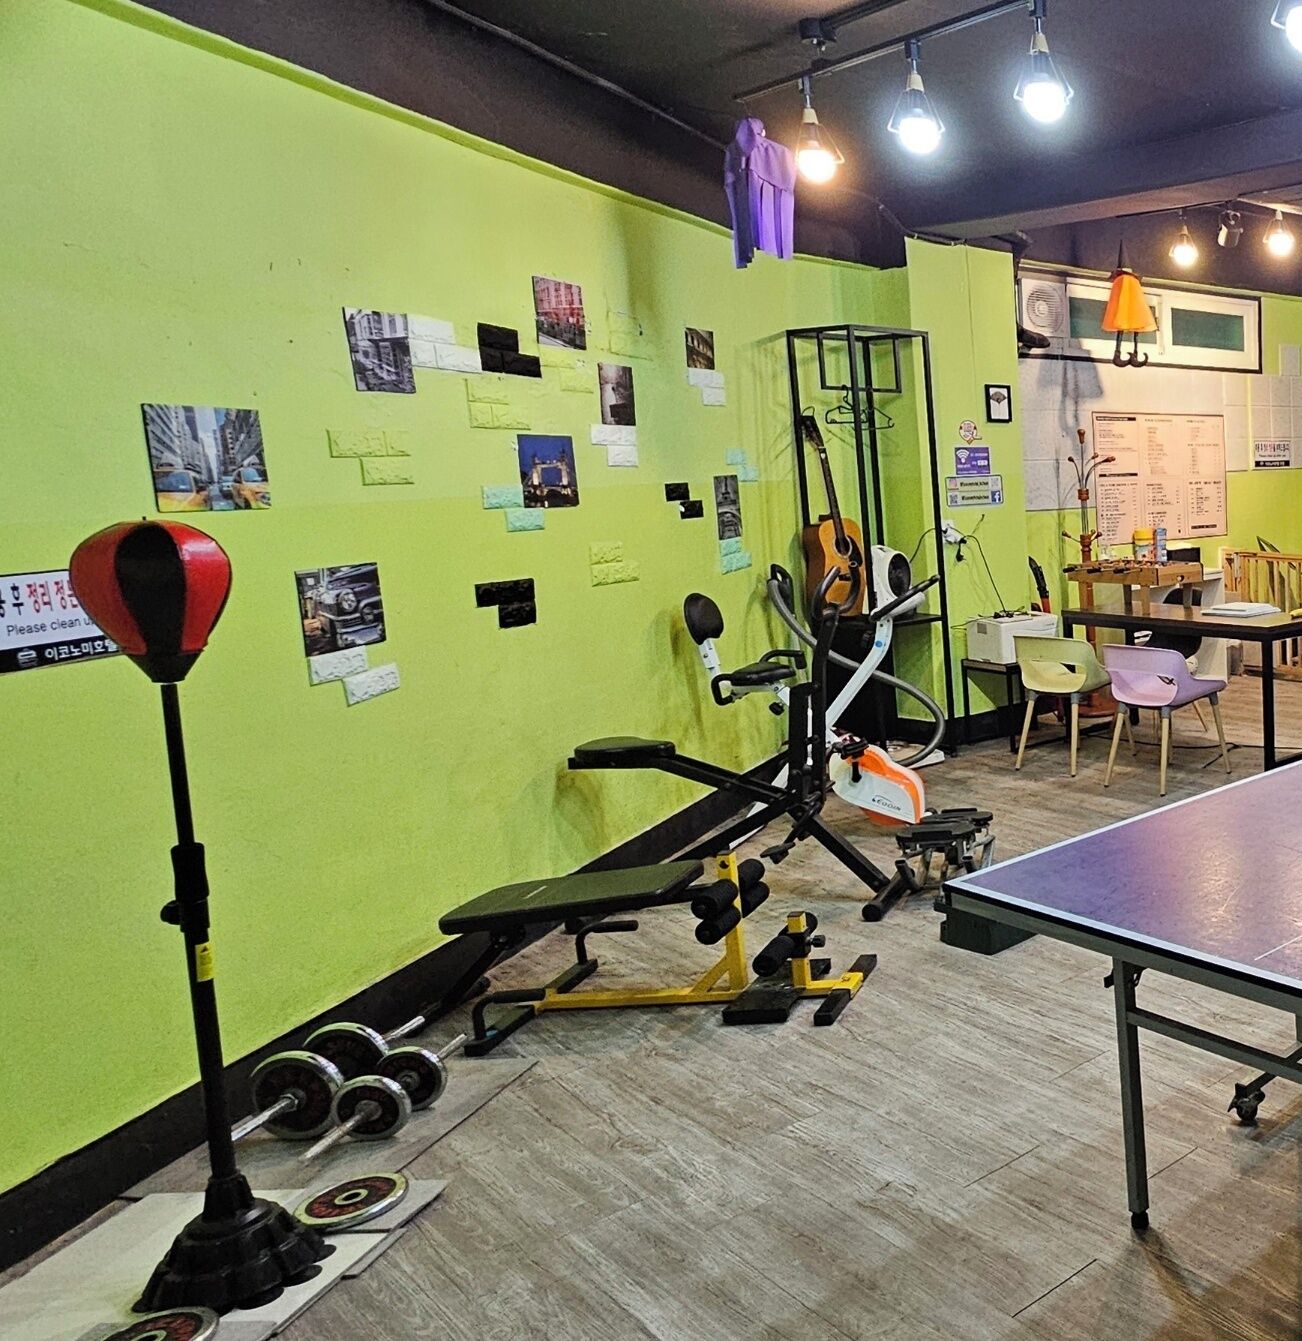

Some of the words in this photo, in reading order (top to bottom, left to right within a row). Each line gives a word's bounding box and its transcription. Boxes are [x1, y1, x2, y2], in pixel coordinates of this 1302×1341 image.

[10, 583, 24, 616] 후
[26, 580, 53, 614] 정리
[6, 624, 48, 637] Please
[50, 618, 81, 631] clean
